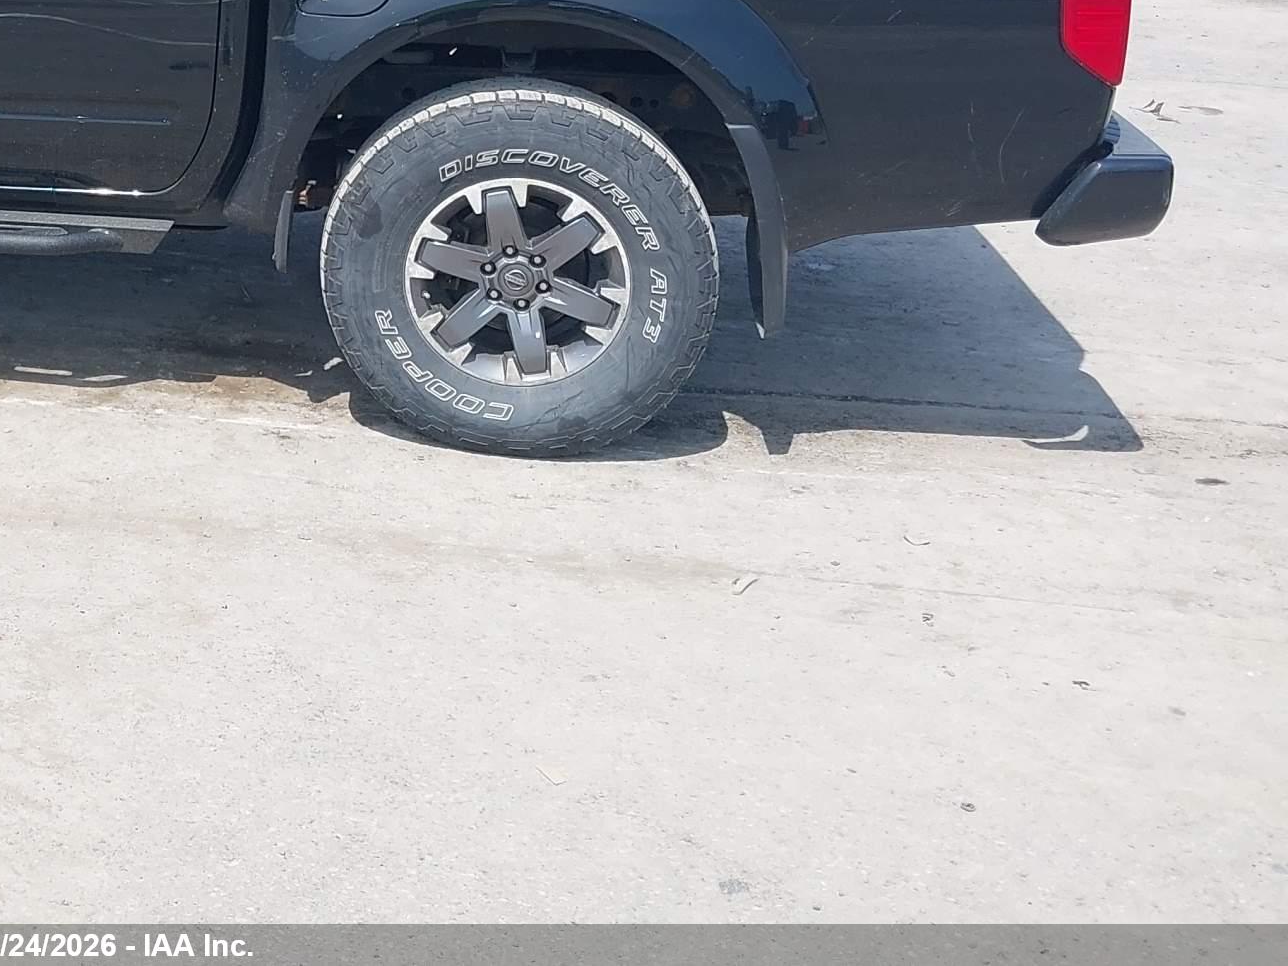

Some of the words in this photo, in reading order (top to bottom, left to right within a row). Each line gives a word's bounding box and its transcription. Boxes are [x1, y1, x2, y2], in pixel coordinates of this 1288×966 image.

[438, 148, 661, 252] DISCOVERER
[642, 266, 668, 344] AT3
[375, 310, 514, 421] COOPER
